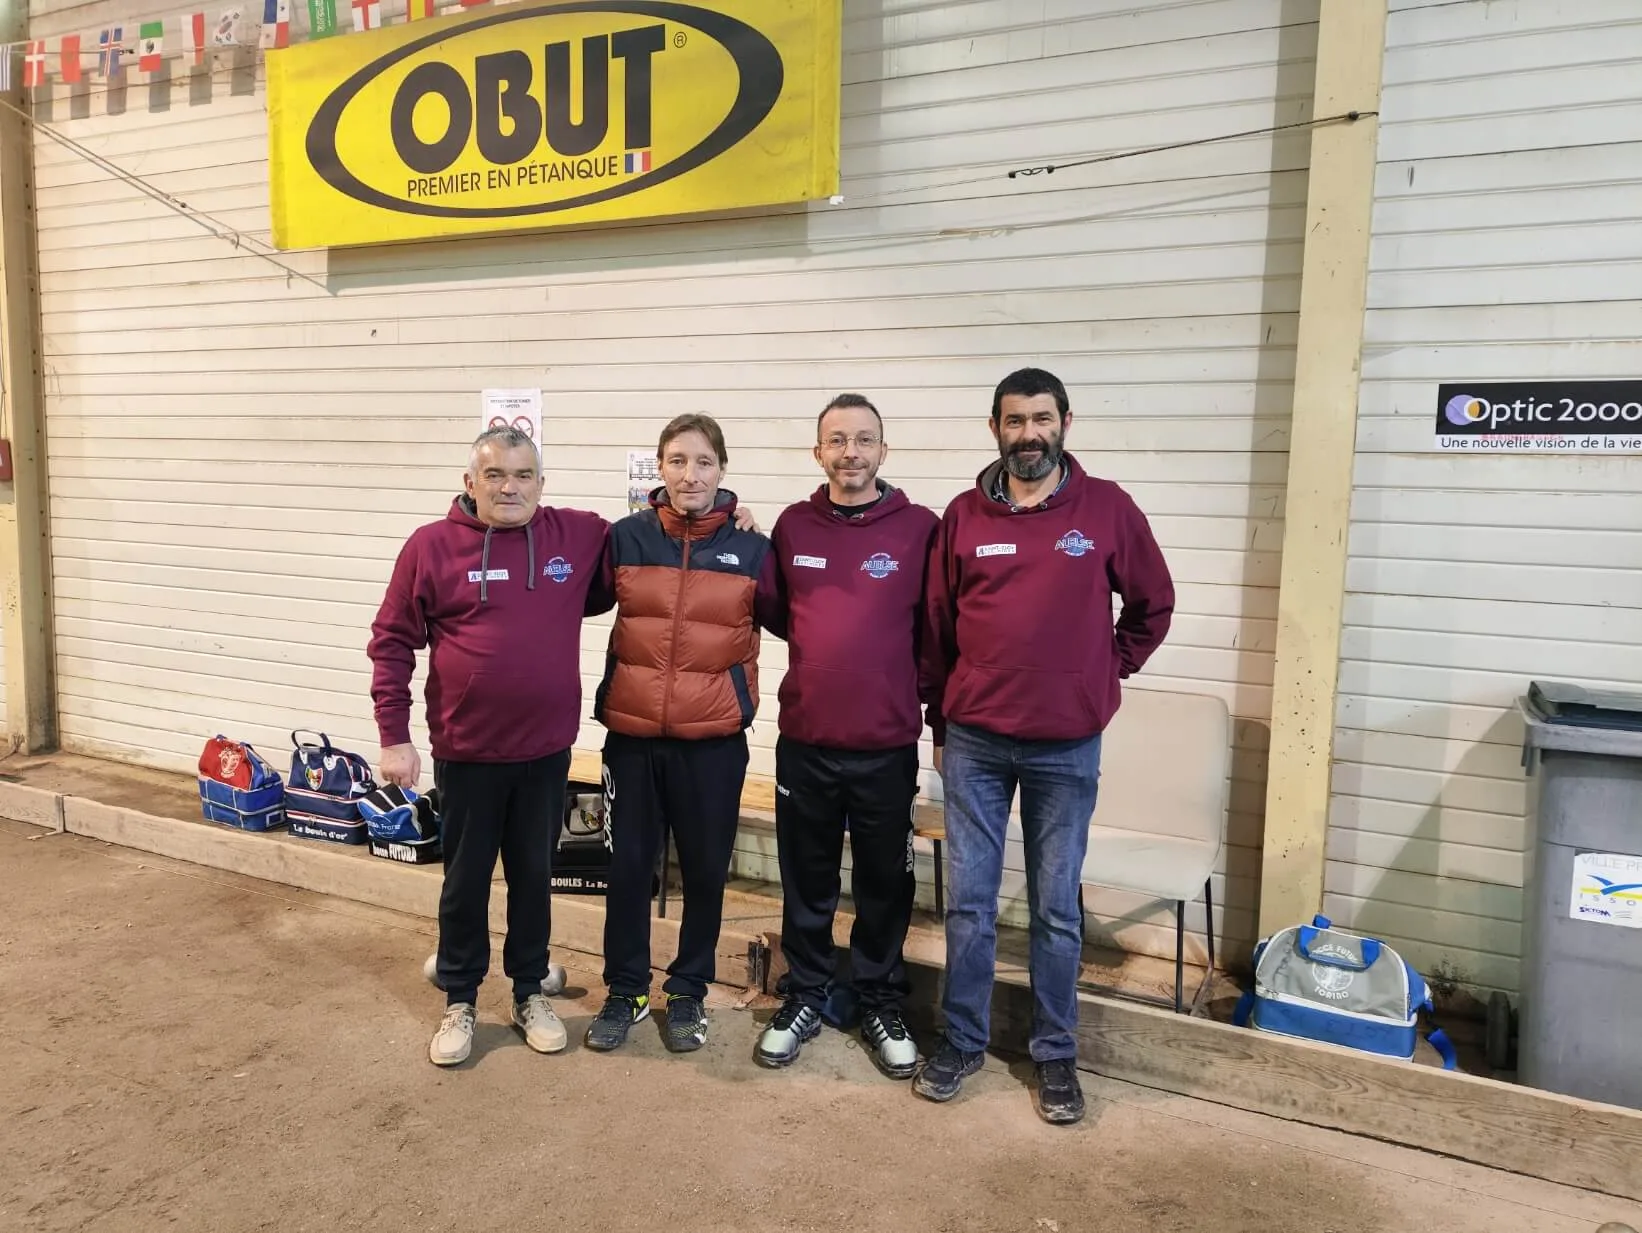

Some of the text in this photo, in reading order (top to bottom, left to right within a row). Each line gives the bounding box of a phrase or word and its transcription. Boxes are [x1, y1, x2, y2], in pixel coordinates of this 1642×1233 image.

[390, 24, 666, 174] OBUT
[407, 154, 619, 198] PREMIER EN PÉTANQUE
[1463, 396, 1553, 430] Optic
[1440, 436, 1469, 449] Une
[1472, 435, 1531, 449] nouvelle
[1535, 436, 1577, 449] vision
[1580, 435, 1600, 449] de
[1603, 435, 1616, 449] la
[1620, 436, 1642, 450] vie
[389, 843, 417, 863] FUTURA
[550, 877, 583, 888] BOULES
[1314, 985, 1350, 1000] TORINO
